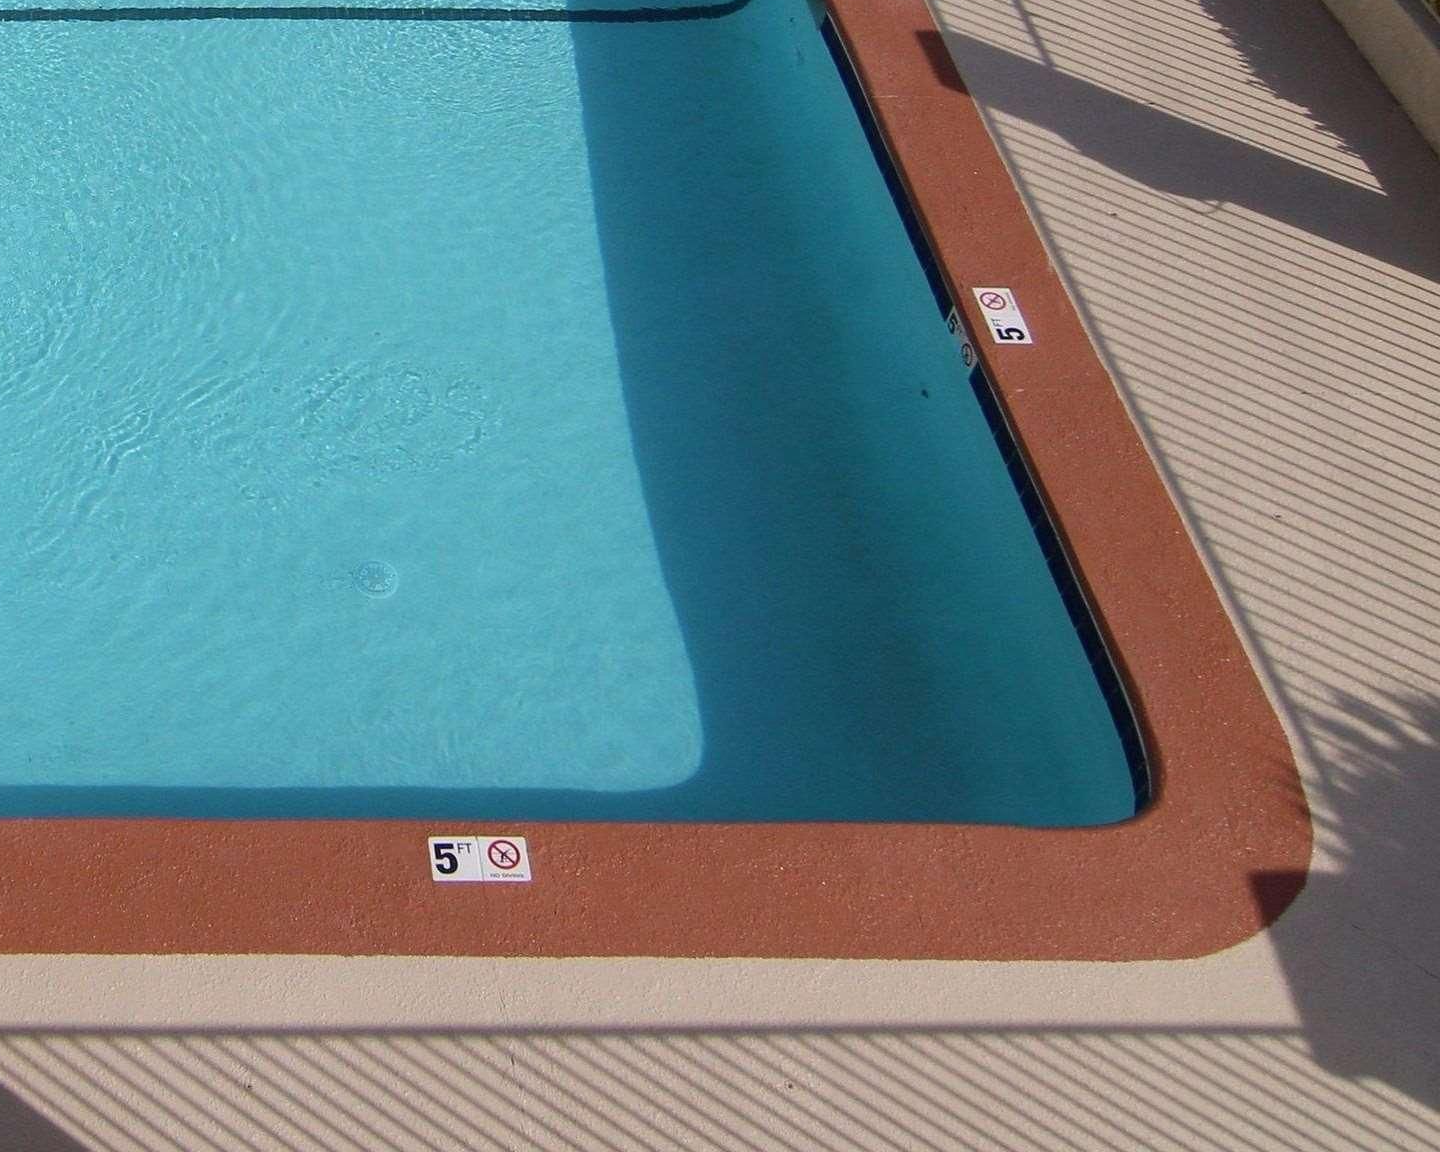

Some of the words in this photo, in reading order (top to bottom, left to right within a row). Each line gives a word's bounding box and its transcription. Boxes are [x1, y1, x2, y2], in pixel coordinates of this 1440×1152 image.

[996, 328, 1025, 341] 5
[433, 843, 459, 874] 5
[456, 842, 472, 853] FT
